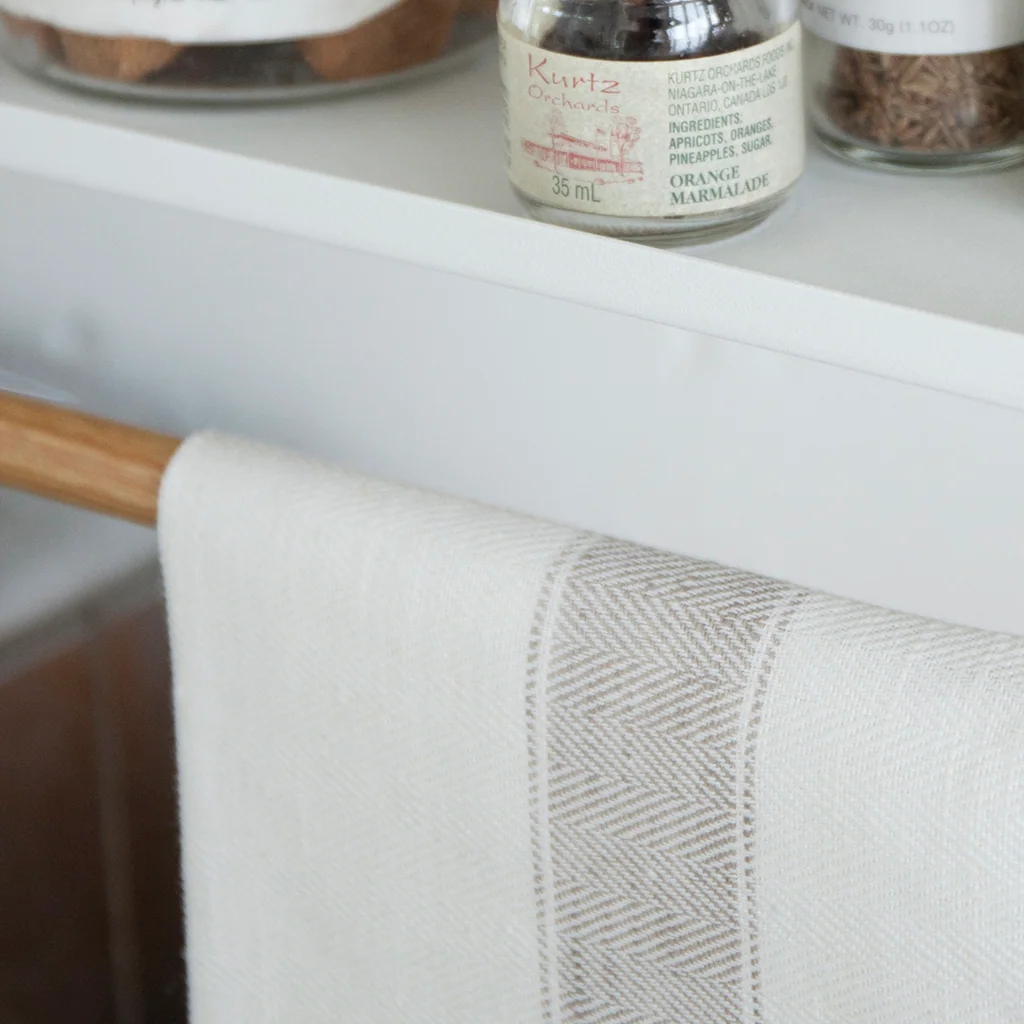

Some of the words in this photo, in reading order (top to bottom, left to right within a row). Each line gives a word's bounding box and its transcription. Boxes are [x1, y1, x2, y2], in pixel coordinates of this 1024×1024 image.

[868, 17, 895, 35] 30g
[527, 53, 621, 95] Kurtz
[667, 68, 706, 85] KURTZ
[707, 56, 761, 81] ORCHARDS
[528, 84, 620, 115] Orchards
[667, 98, 721, 117] ONTARIO,
[723, 87, 760, 109] CANADA
[668, 112, 743, 134] INGREDIENTS:
[551, 176, 570, 198] 35
[574, 181, 602, 203] mL
[669, 165, 740, 188] ORANGE
[670, 173, 770, 206] MARMALADE
